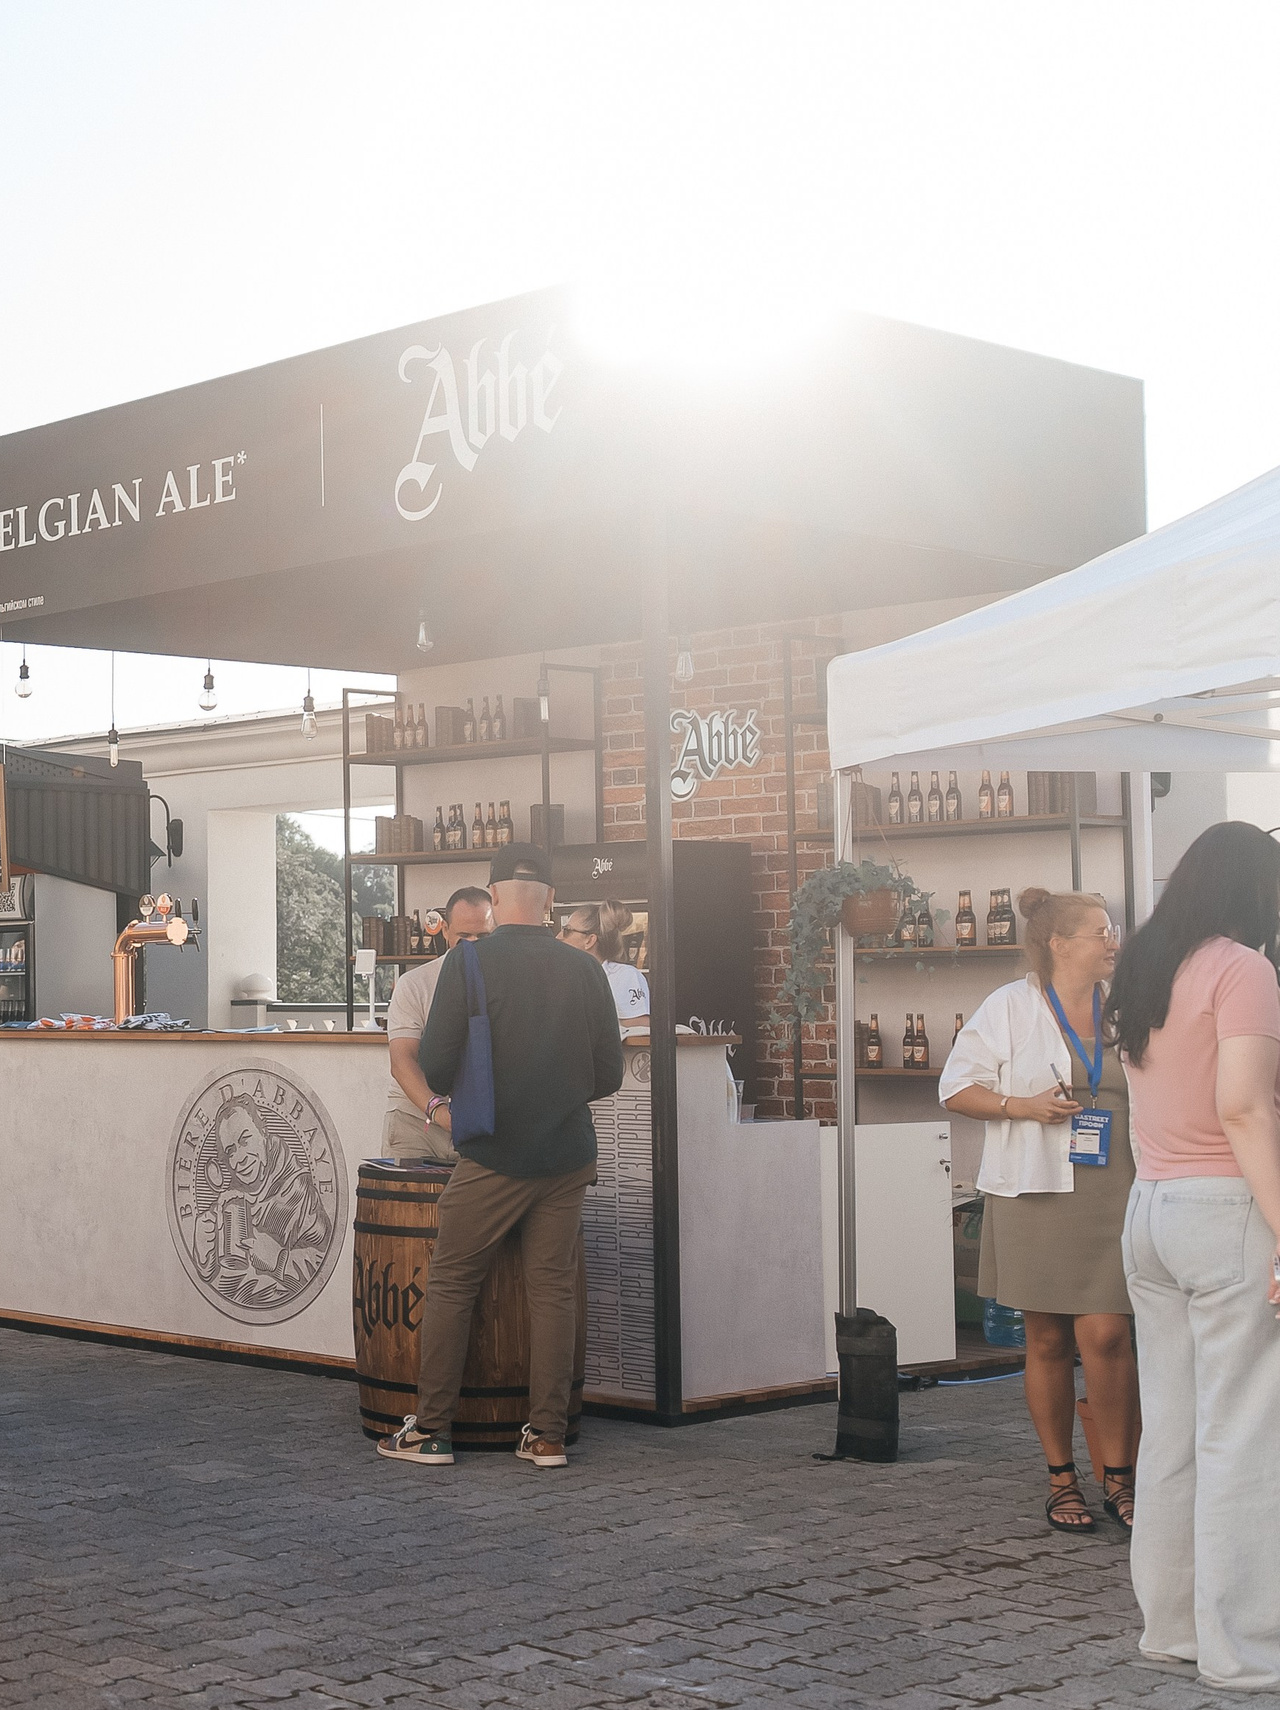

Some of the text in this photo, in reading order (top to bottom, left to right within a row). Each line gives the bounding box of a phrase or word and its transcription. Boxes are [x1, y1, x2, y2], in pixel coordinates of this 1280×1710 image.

[27, 595, 44, 607] стиле
[670, 710, 760, 801] Abbé
[592, 857, 613, 879] Abbé
[177, 1107, 210, 1221] BIÈRE
[587, 1094, 617, 1189] АЛКОГОЛЬНО
